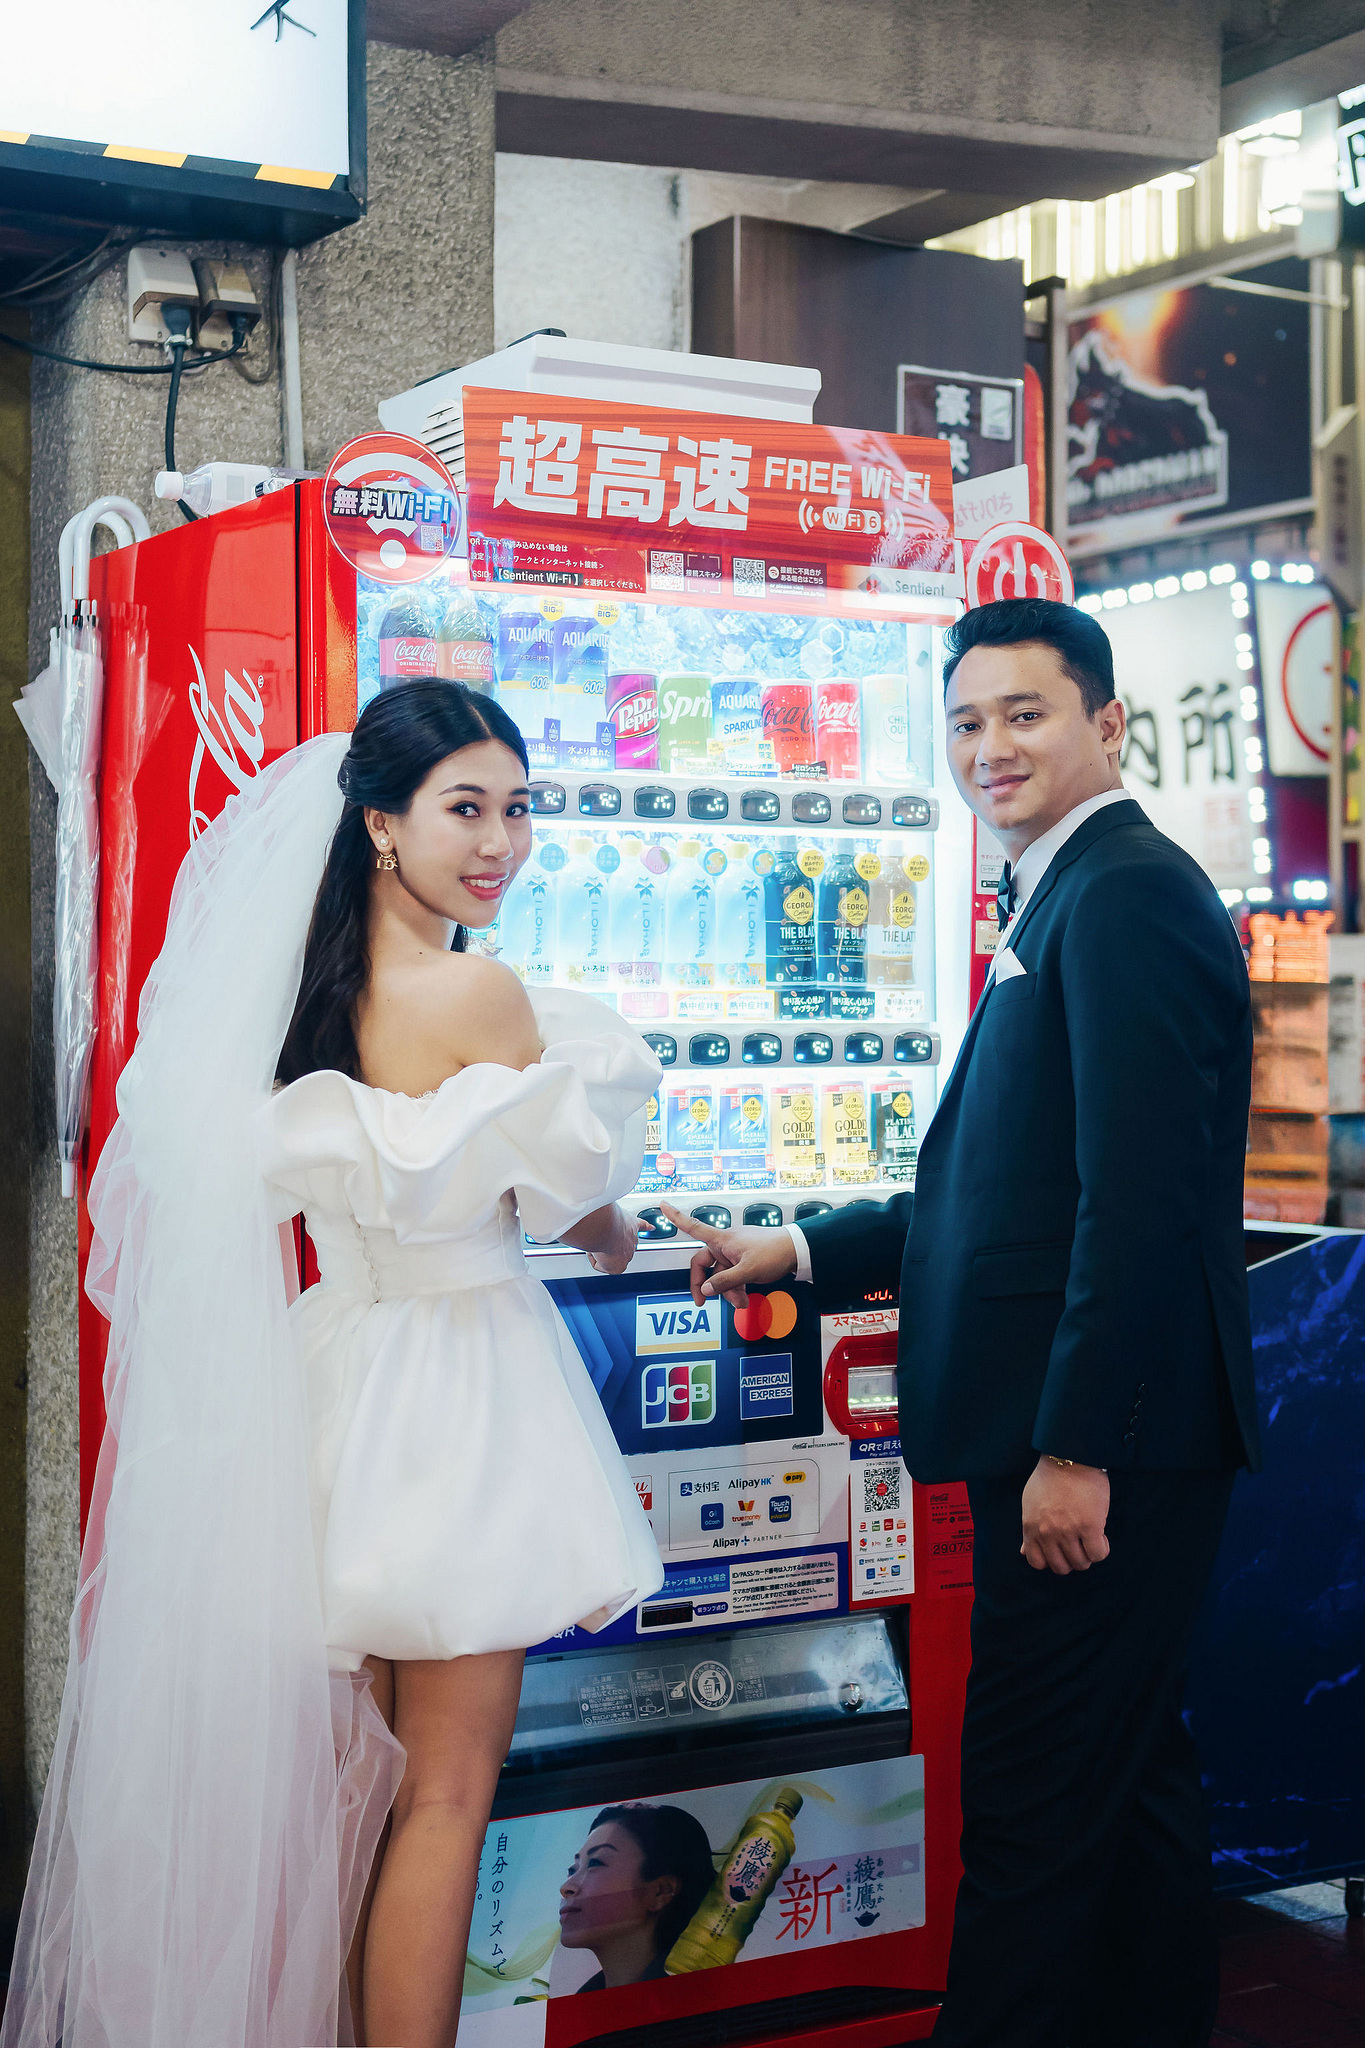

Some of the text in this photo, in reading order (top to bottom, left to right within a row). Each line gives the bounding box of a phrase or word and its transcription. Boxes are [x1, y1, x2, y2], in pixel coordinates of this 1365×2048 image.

[493, 416, 752, 531] 超高速
[764, 457, 931, 504] FREE Wi-Fi
[894, 579, 945, 597] Sentient
[633, 697, 653, 715] Dr
[567, 745, 611, 757] 水より優れた
[780, 927, 796, 939] THE
[833, 927, 849, 939] THE
[882, 930, 899, 942] THE
[647, 1309, 711, 1336] VISA
[741, 1374, 789, 1388] AMERICAN
[644, 1383, 711, 1406] JCB
[750, 1388, 793, 1401] EXPRESS
[693, 1481, 720, 1494] 支付宝
[753, 1534, 782, 1542] PARTNER
[933, 1541, 972, 1555] 29073
[734, 1837, 772, 1889] 綾鷹
[853, 1855, 877, 1911] 綾鷹
[489, 1832, 509, 1976] 自分のリズムで
[775, 1863, 845, 1942] 新
